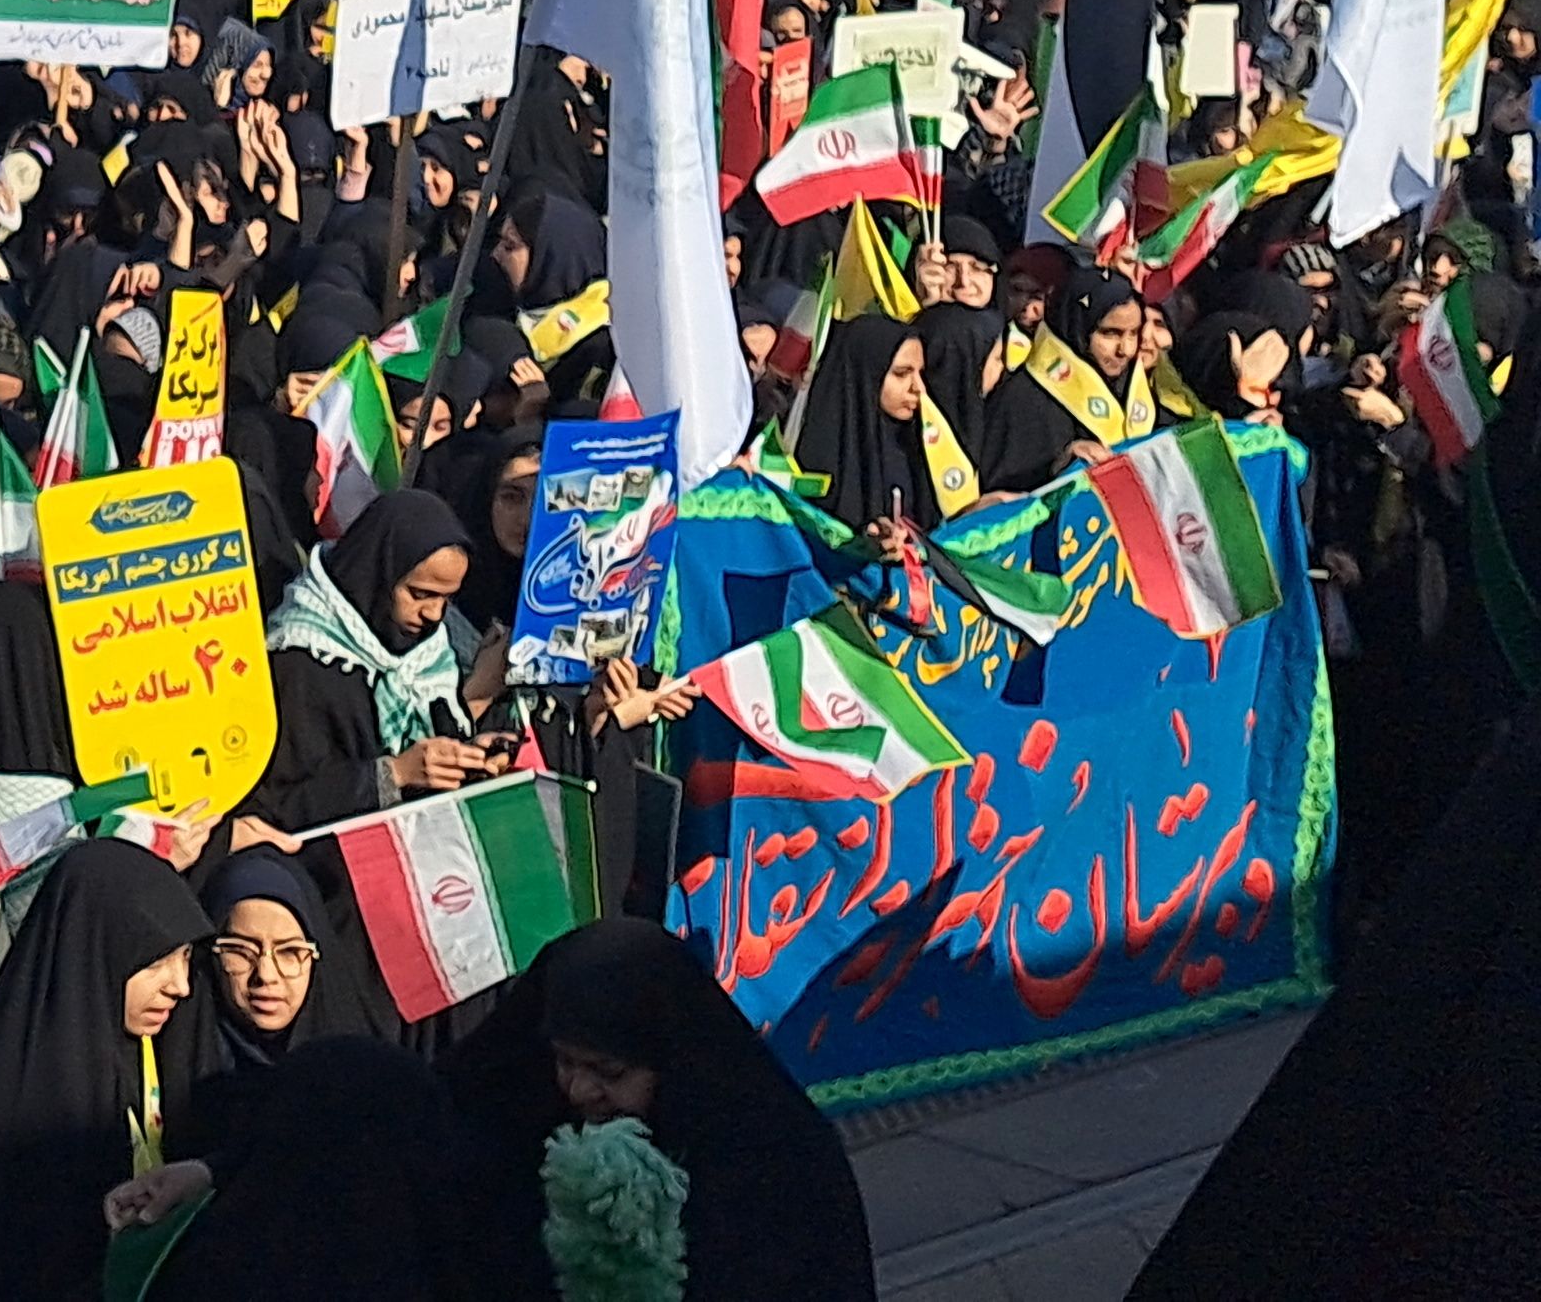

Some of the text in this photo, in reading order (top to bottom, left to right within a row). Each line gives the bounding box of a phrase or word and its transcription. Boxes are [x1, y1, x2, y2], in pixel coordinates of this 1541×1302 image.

[58, 539, 241, 593] به کوری چشم آمریکا
[72, 579, 249, 654] انقلاب اسلامی
[88, 639, 248, 715] ۴۰ ساله شد
